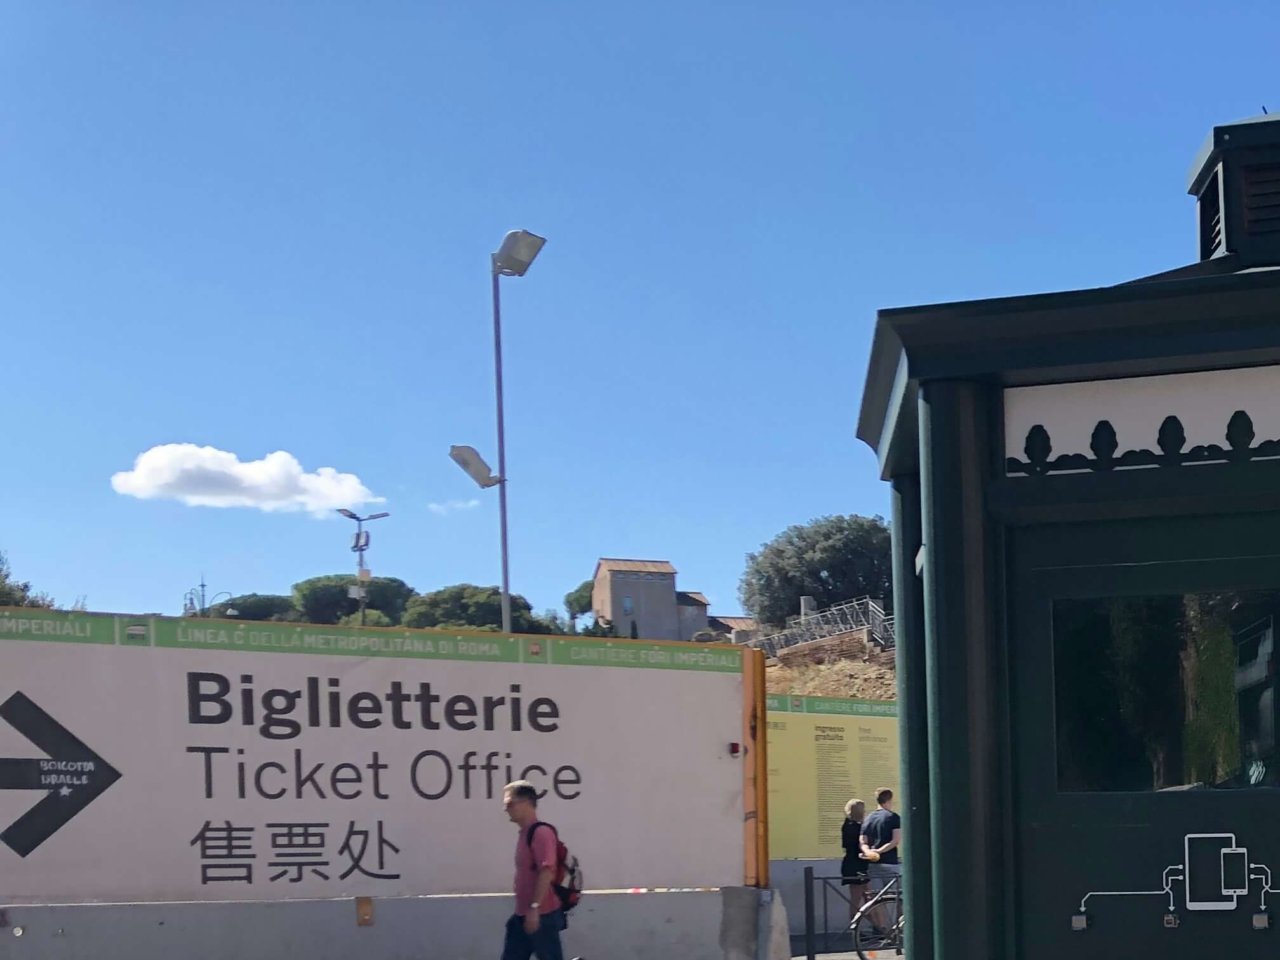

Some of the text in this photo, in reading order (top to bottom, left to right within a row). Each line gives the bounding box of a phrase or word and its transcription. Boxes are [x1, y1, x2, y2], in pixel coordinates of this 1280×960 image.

[177, 627, 228, 643] LINEA
[233, 630, 246, 645] C
[250, 632, 301, 647] DELLA
[304, 634, 434, 653] METROPOLITANA
[458, 642, 500, 656] ROMA
[187, 672, 560, 740] Biglietterie
[186, 746, 582, 801] Ticket Office
[189, 820, 401, 885] 售票处
